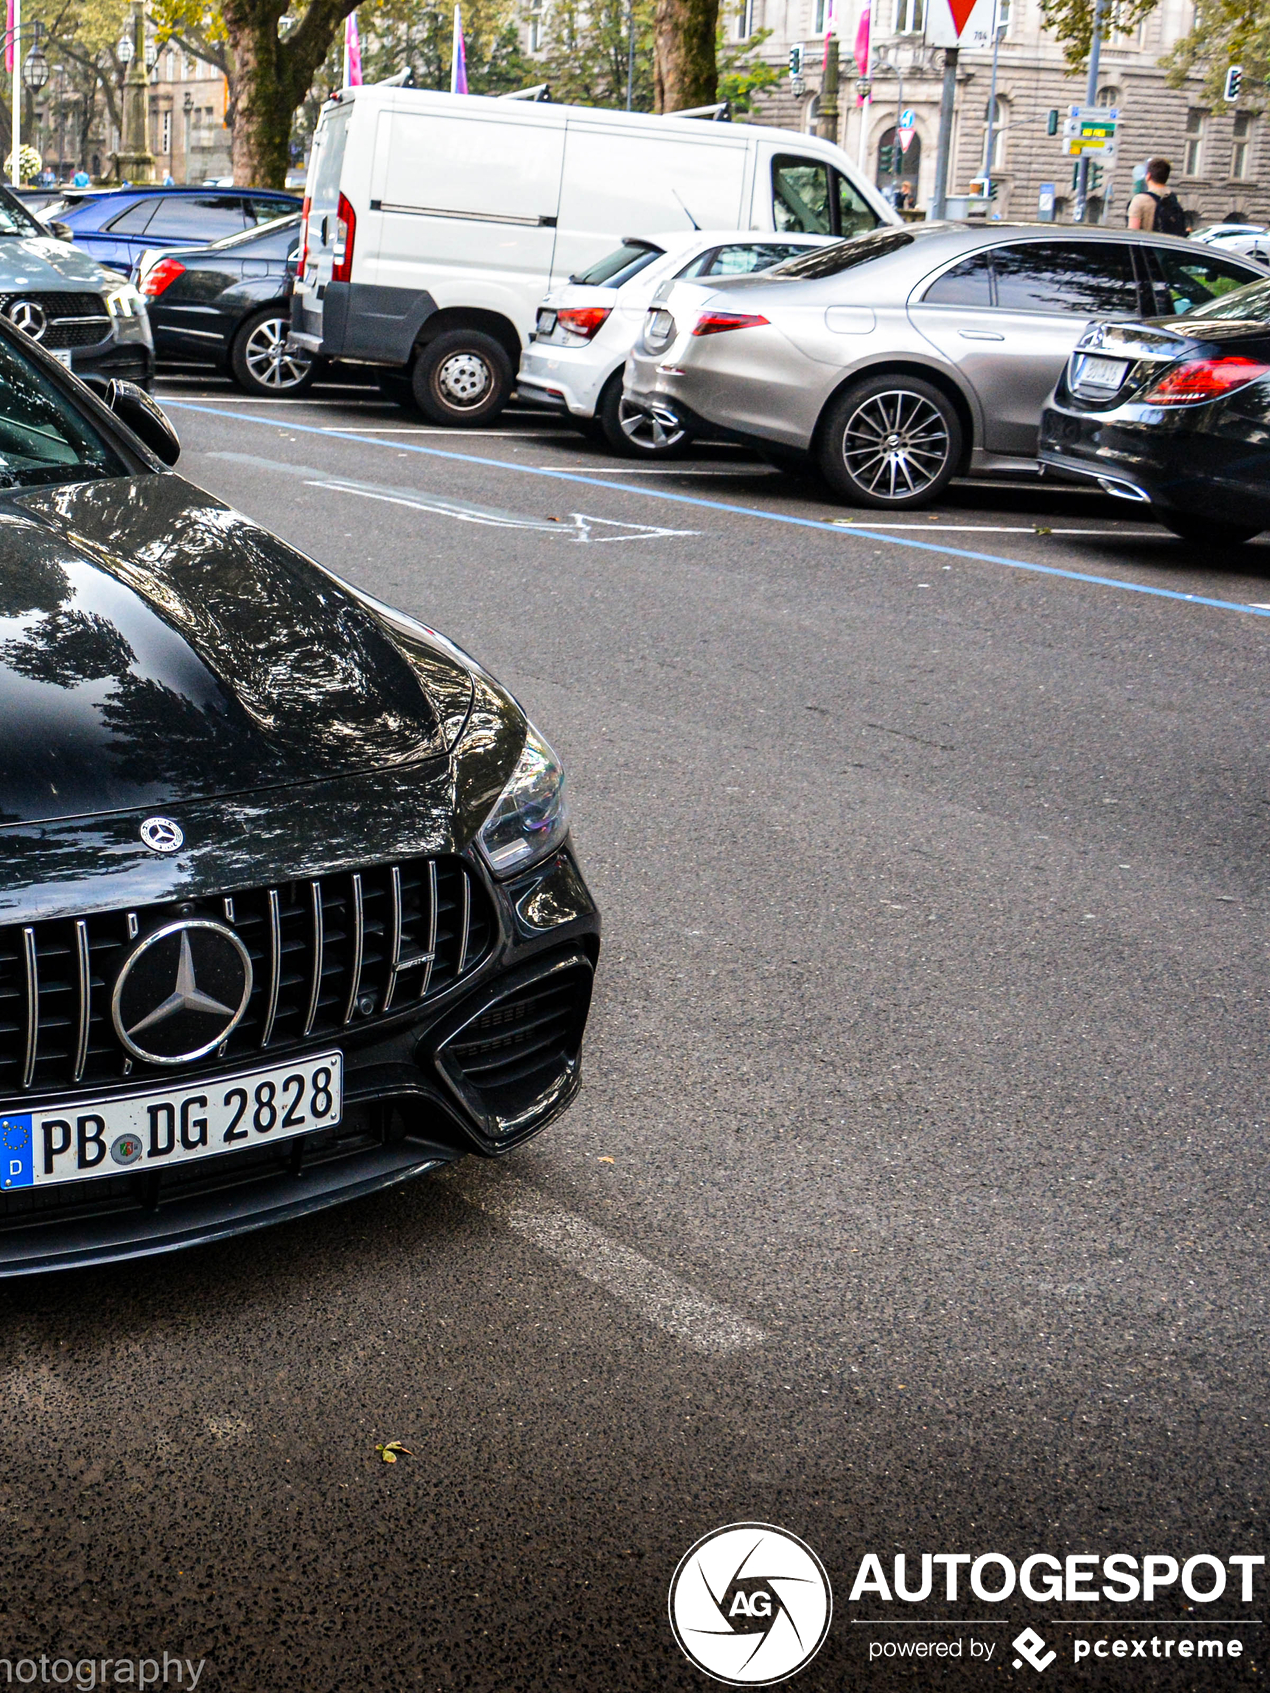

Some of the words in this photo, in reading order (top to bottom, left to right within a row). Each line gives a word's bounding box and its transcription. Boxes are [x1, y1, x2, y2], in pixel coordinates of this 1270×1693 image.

[9, 1159, 23, 1176] D
[40, 1113, 107, 1175] PB
[146, 1095, 208, 1158] DG
[222, 1066, 333, 1143] 2828
